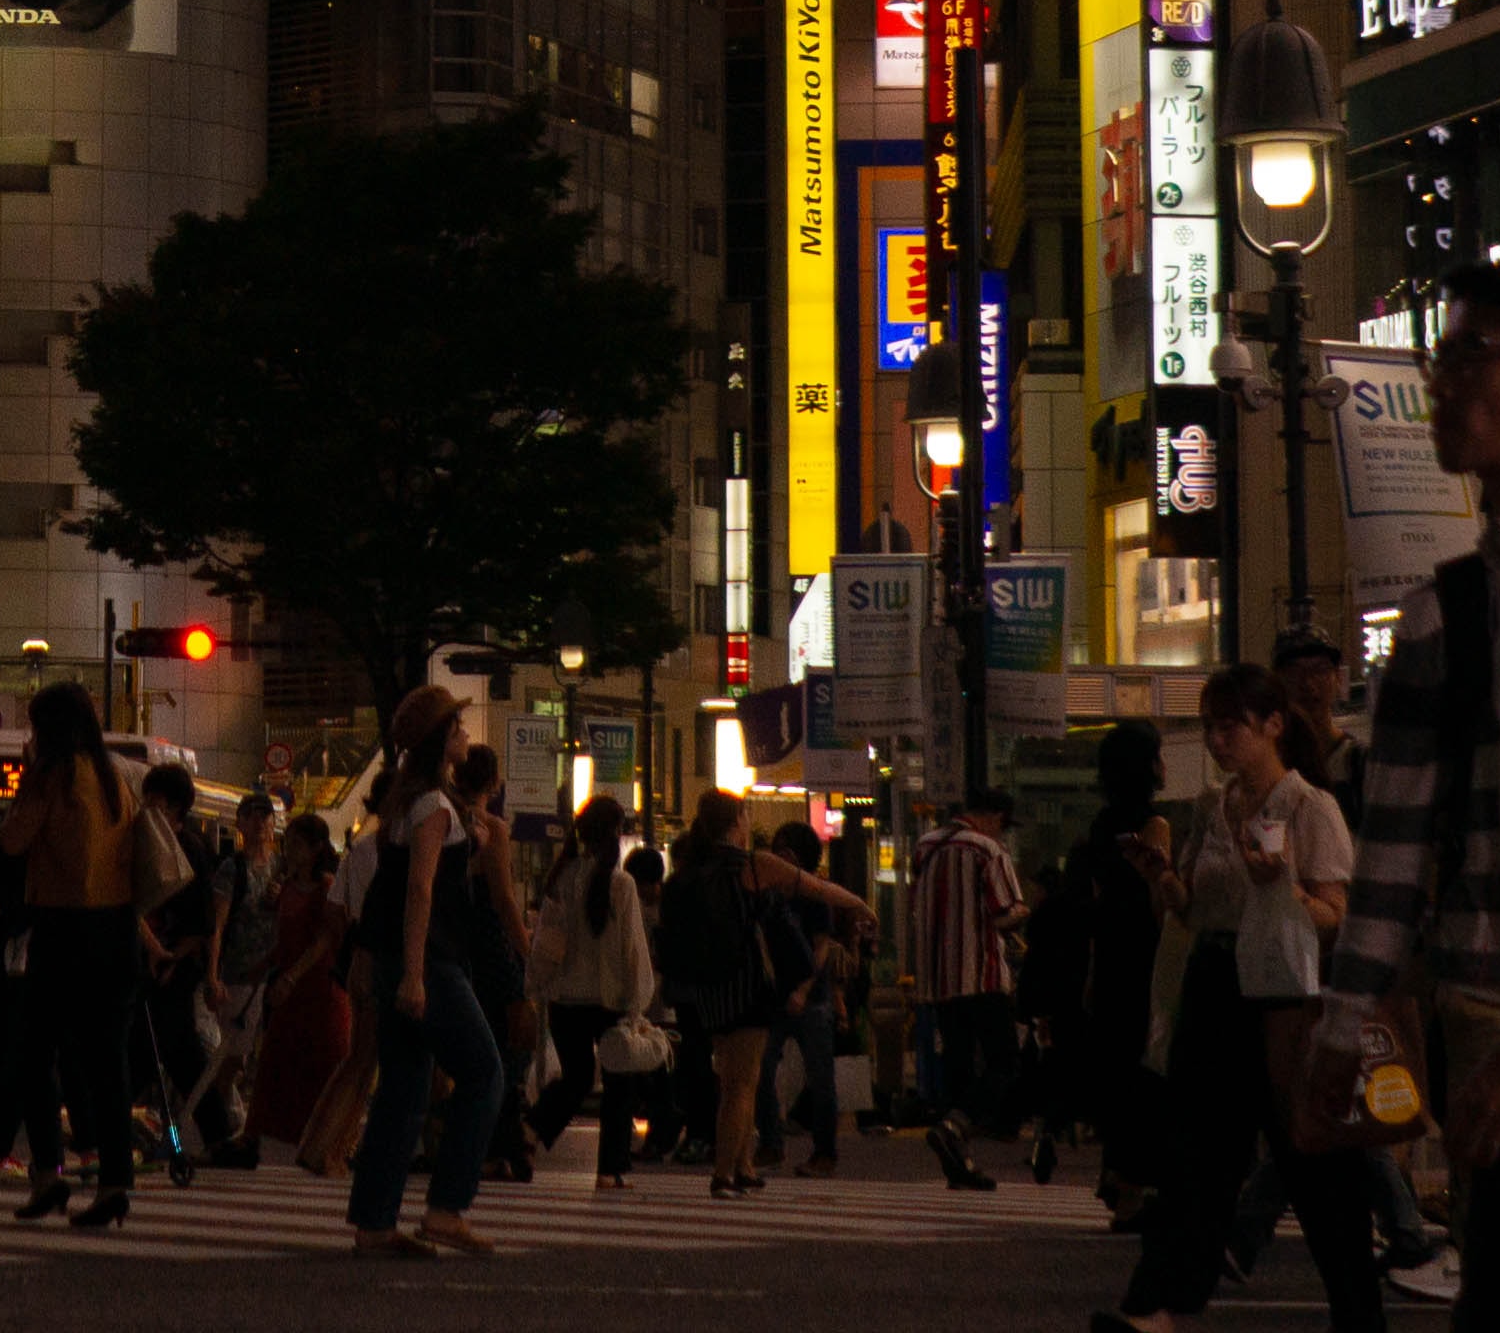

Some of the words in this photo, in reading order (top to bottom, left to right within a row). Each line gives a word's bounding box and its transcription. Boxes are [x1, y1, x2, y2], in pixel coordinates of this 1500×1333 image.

[942, 0, 966, 16] 6F
[798, 69, 823, 257] Matsumoto
[1159, 94, 1180, 176] パーラー
[1185, 83, 1207, 166] フルーツ
[1158, 187, 1181, 204] 2F
[1163, 264, 1182, 345] フルーツ
[1189, 252, 1208, 338] 渋谷西村
[795, 383, 829, 415] 薬
[1164, 357, 1182, 373] 1F
